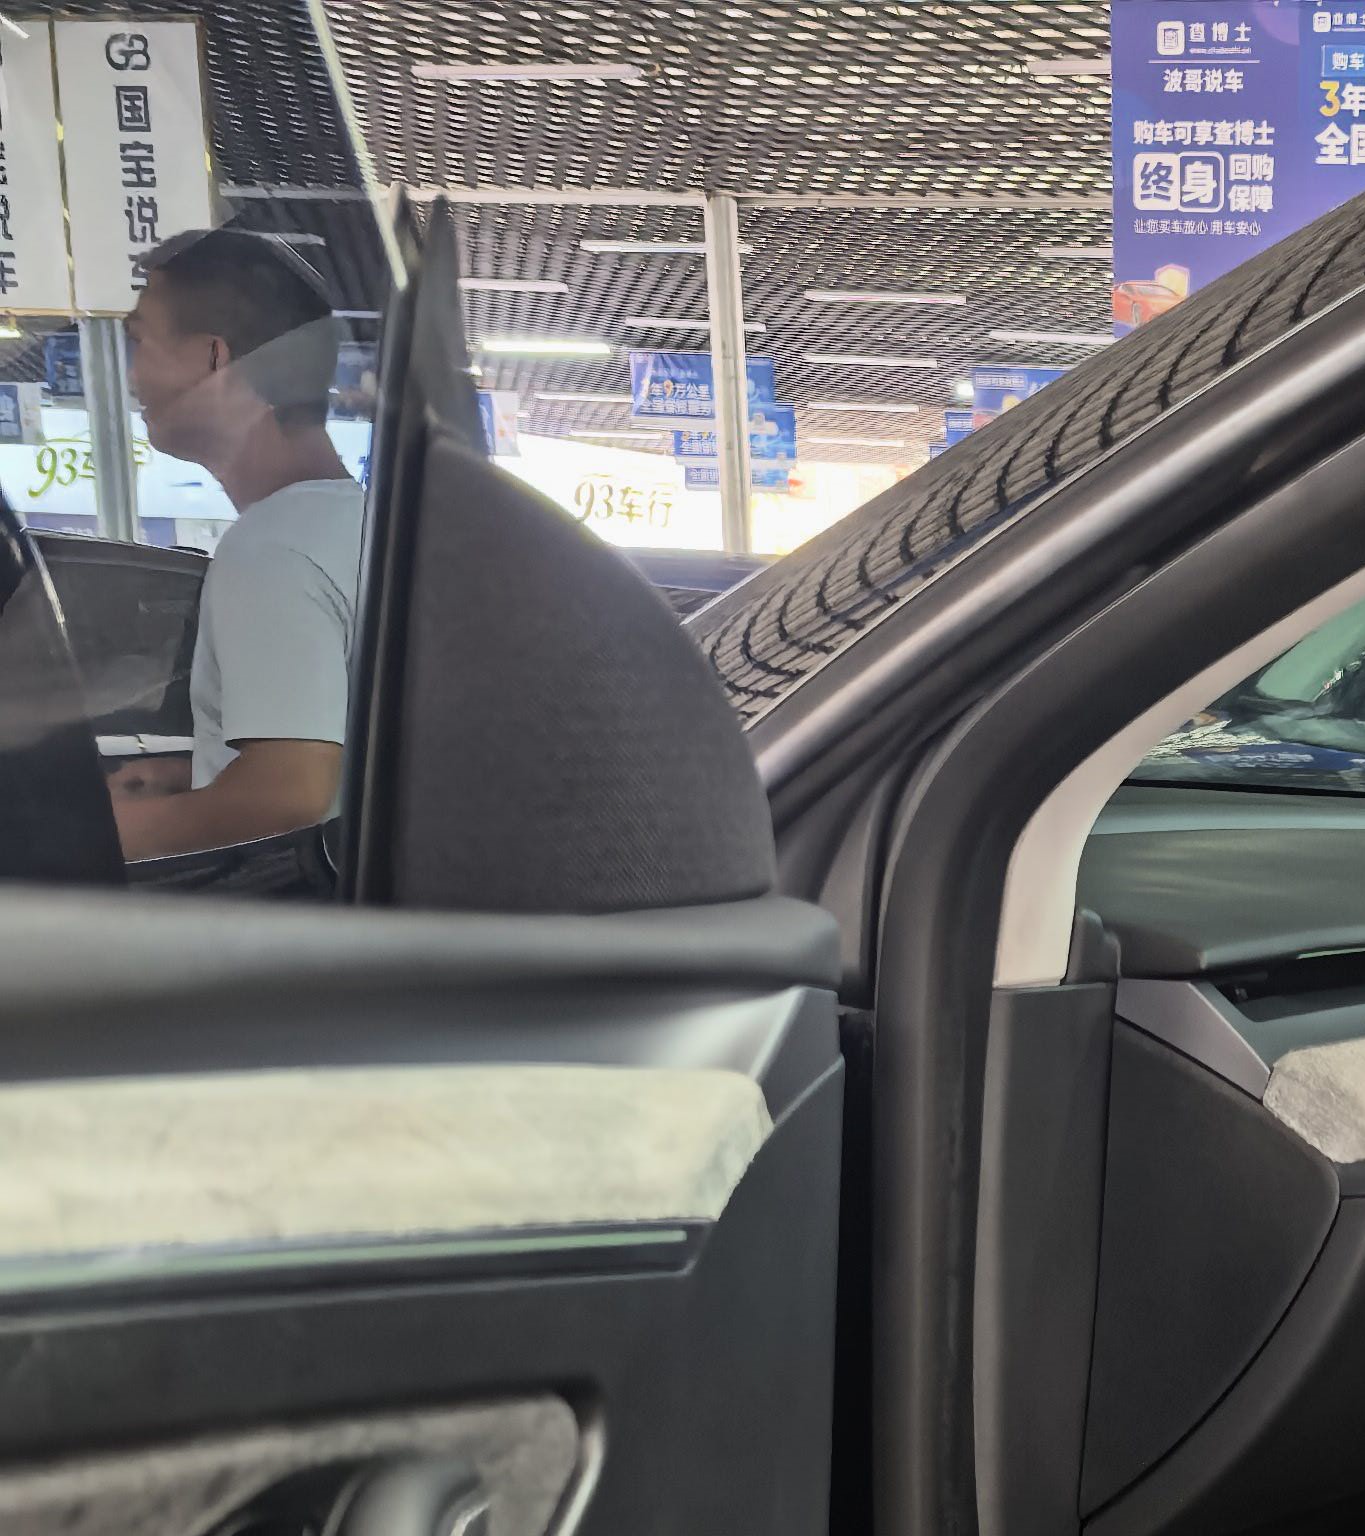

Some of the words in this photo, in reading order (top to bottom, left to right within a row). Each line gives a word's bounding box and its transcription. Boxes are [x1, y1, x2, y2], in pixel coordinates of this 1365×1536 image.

[1188, 22, 1252, 42] 查博士
[1163, 68, 1244, 93] 波哥说车
[1133, 120, 1275, 145] 购车可享查博士
[1229, 153, 1275, 181] 回购
[1140, 160, 1218, 204] 终身
[1227, 185, 1274, 213] 保障
[574, 481, 673, 527] 93车行
